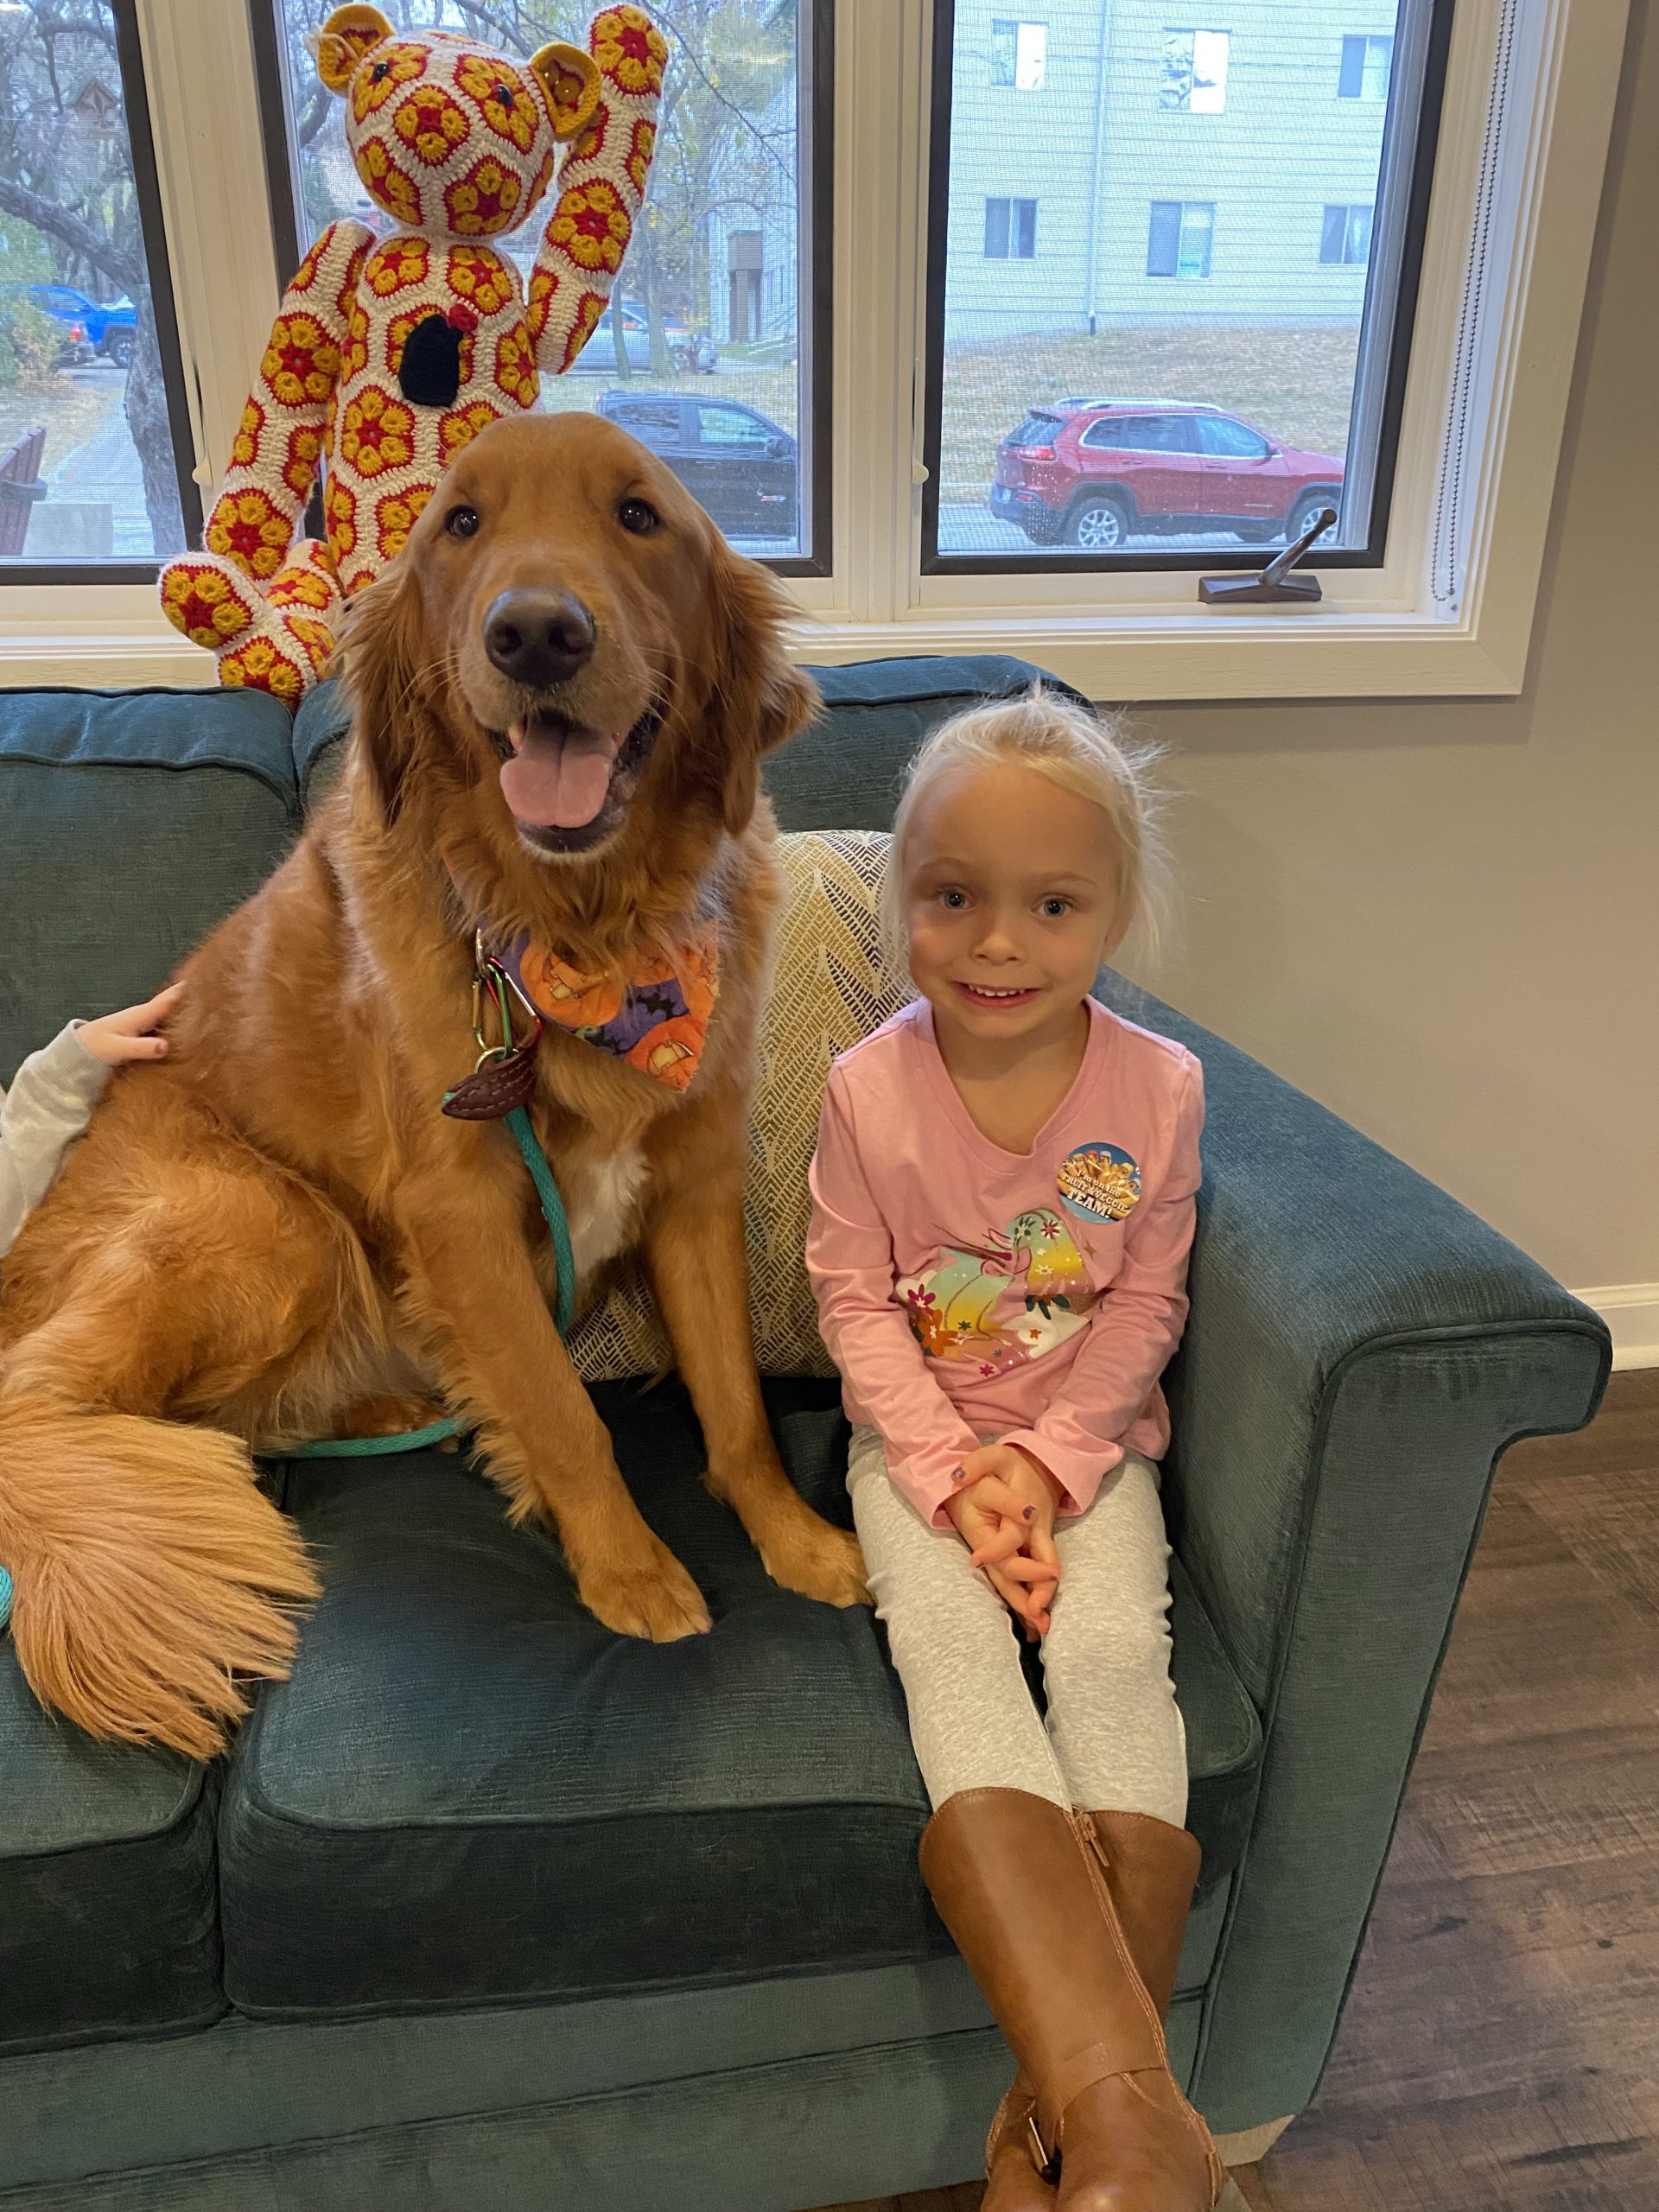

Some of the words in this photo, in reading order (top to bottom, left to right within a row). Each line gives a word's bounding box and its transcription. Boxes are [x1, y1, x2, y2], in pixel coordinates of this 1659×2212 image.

[1062, 1174, 1088, 1191] FRUIT
[1096, 1188, 1128, 1212] VEGGIE
[1067, 1188, 1112, 1218] TEAM!
